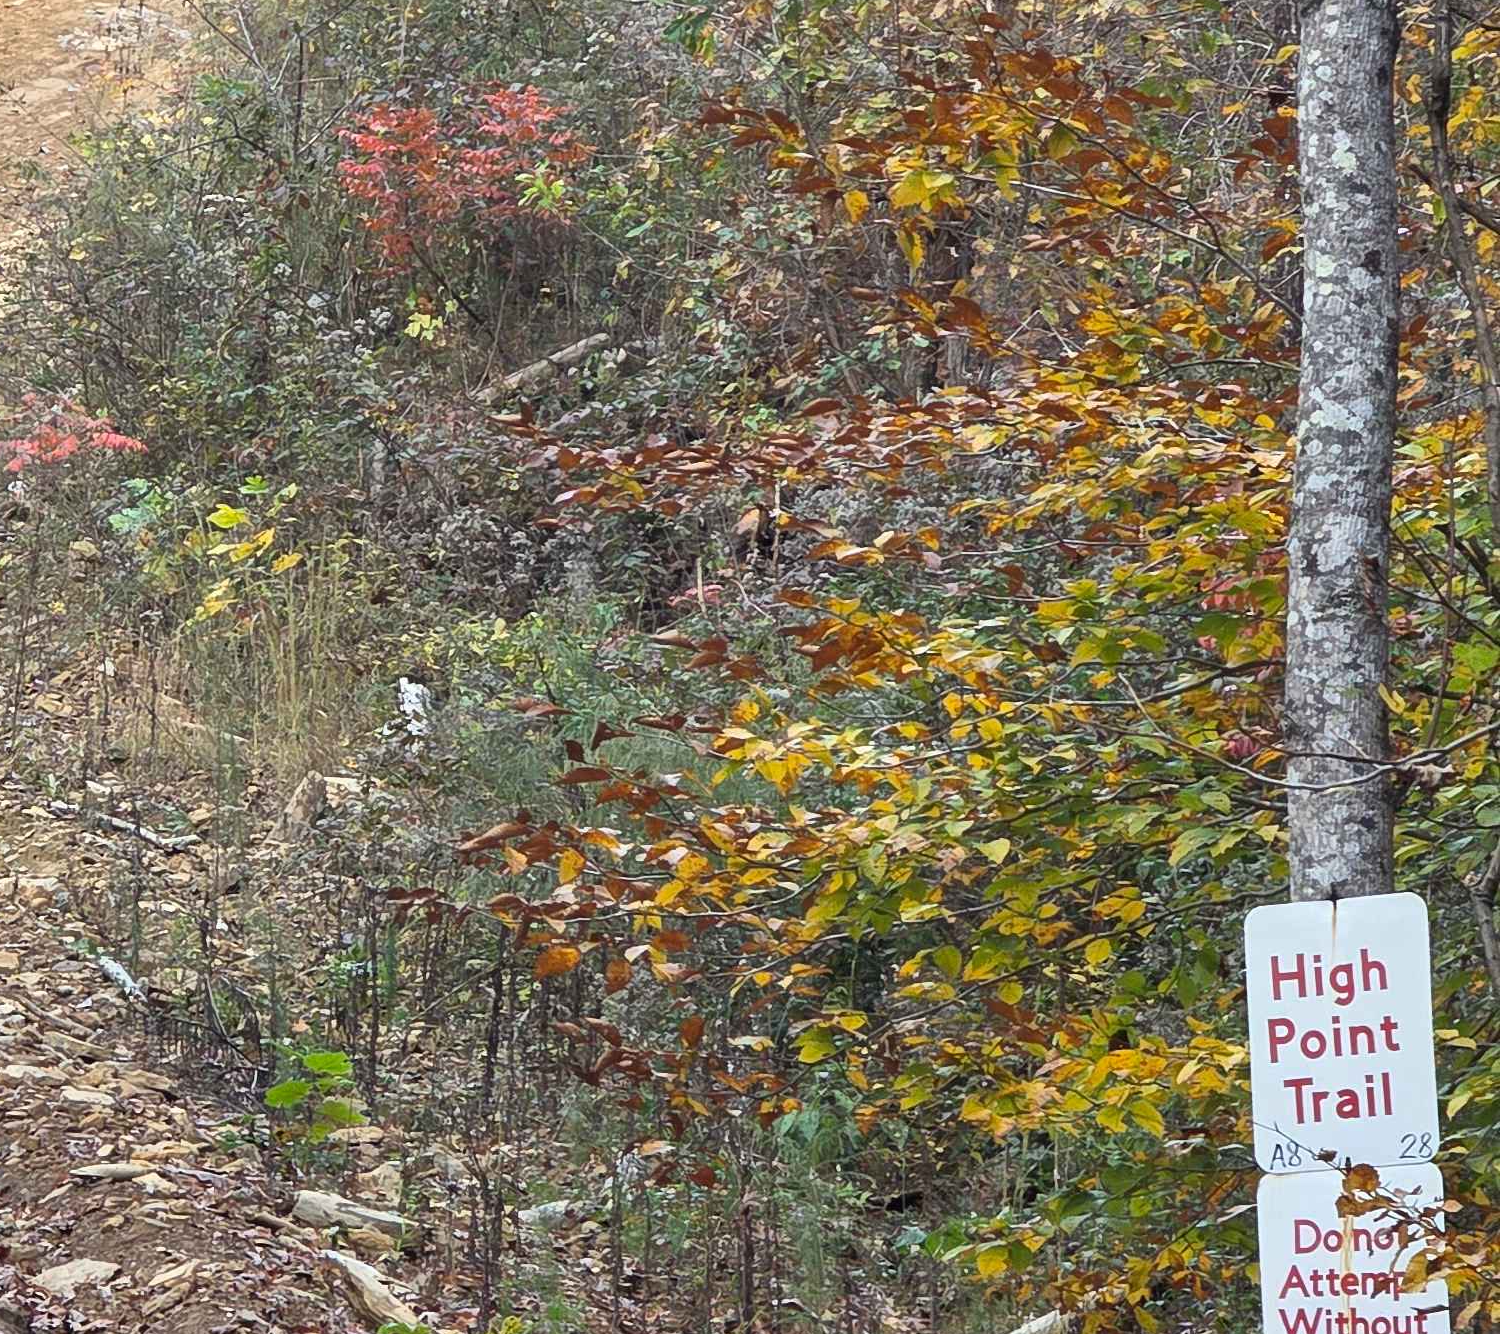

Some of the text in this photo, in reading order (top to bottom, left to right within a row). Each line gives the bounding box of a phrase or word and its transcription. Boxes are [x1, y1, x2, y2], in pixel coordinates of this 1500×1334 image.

[1270, 948, 1388, 1006] High
[1267, 1015, 1400, 1064] Point
[1283, 1072, 1393, 1124] Trail
[1400, 1132, 1433, 1159] 28
[1294, 1219, 1406, 1254] Do no
[1278, 1264, 1427, 1302] Attemp
